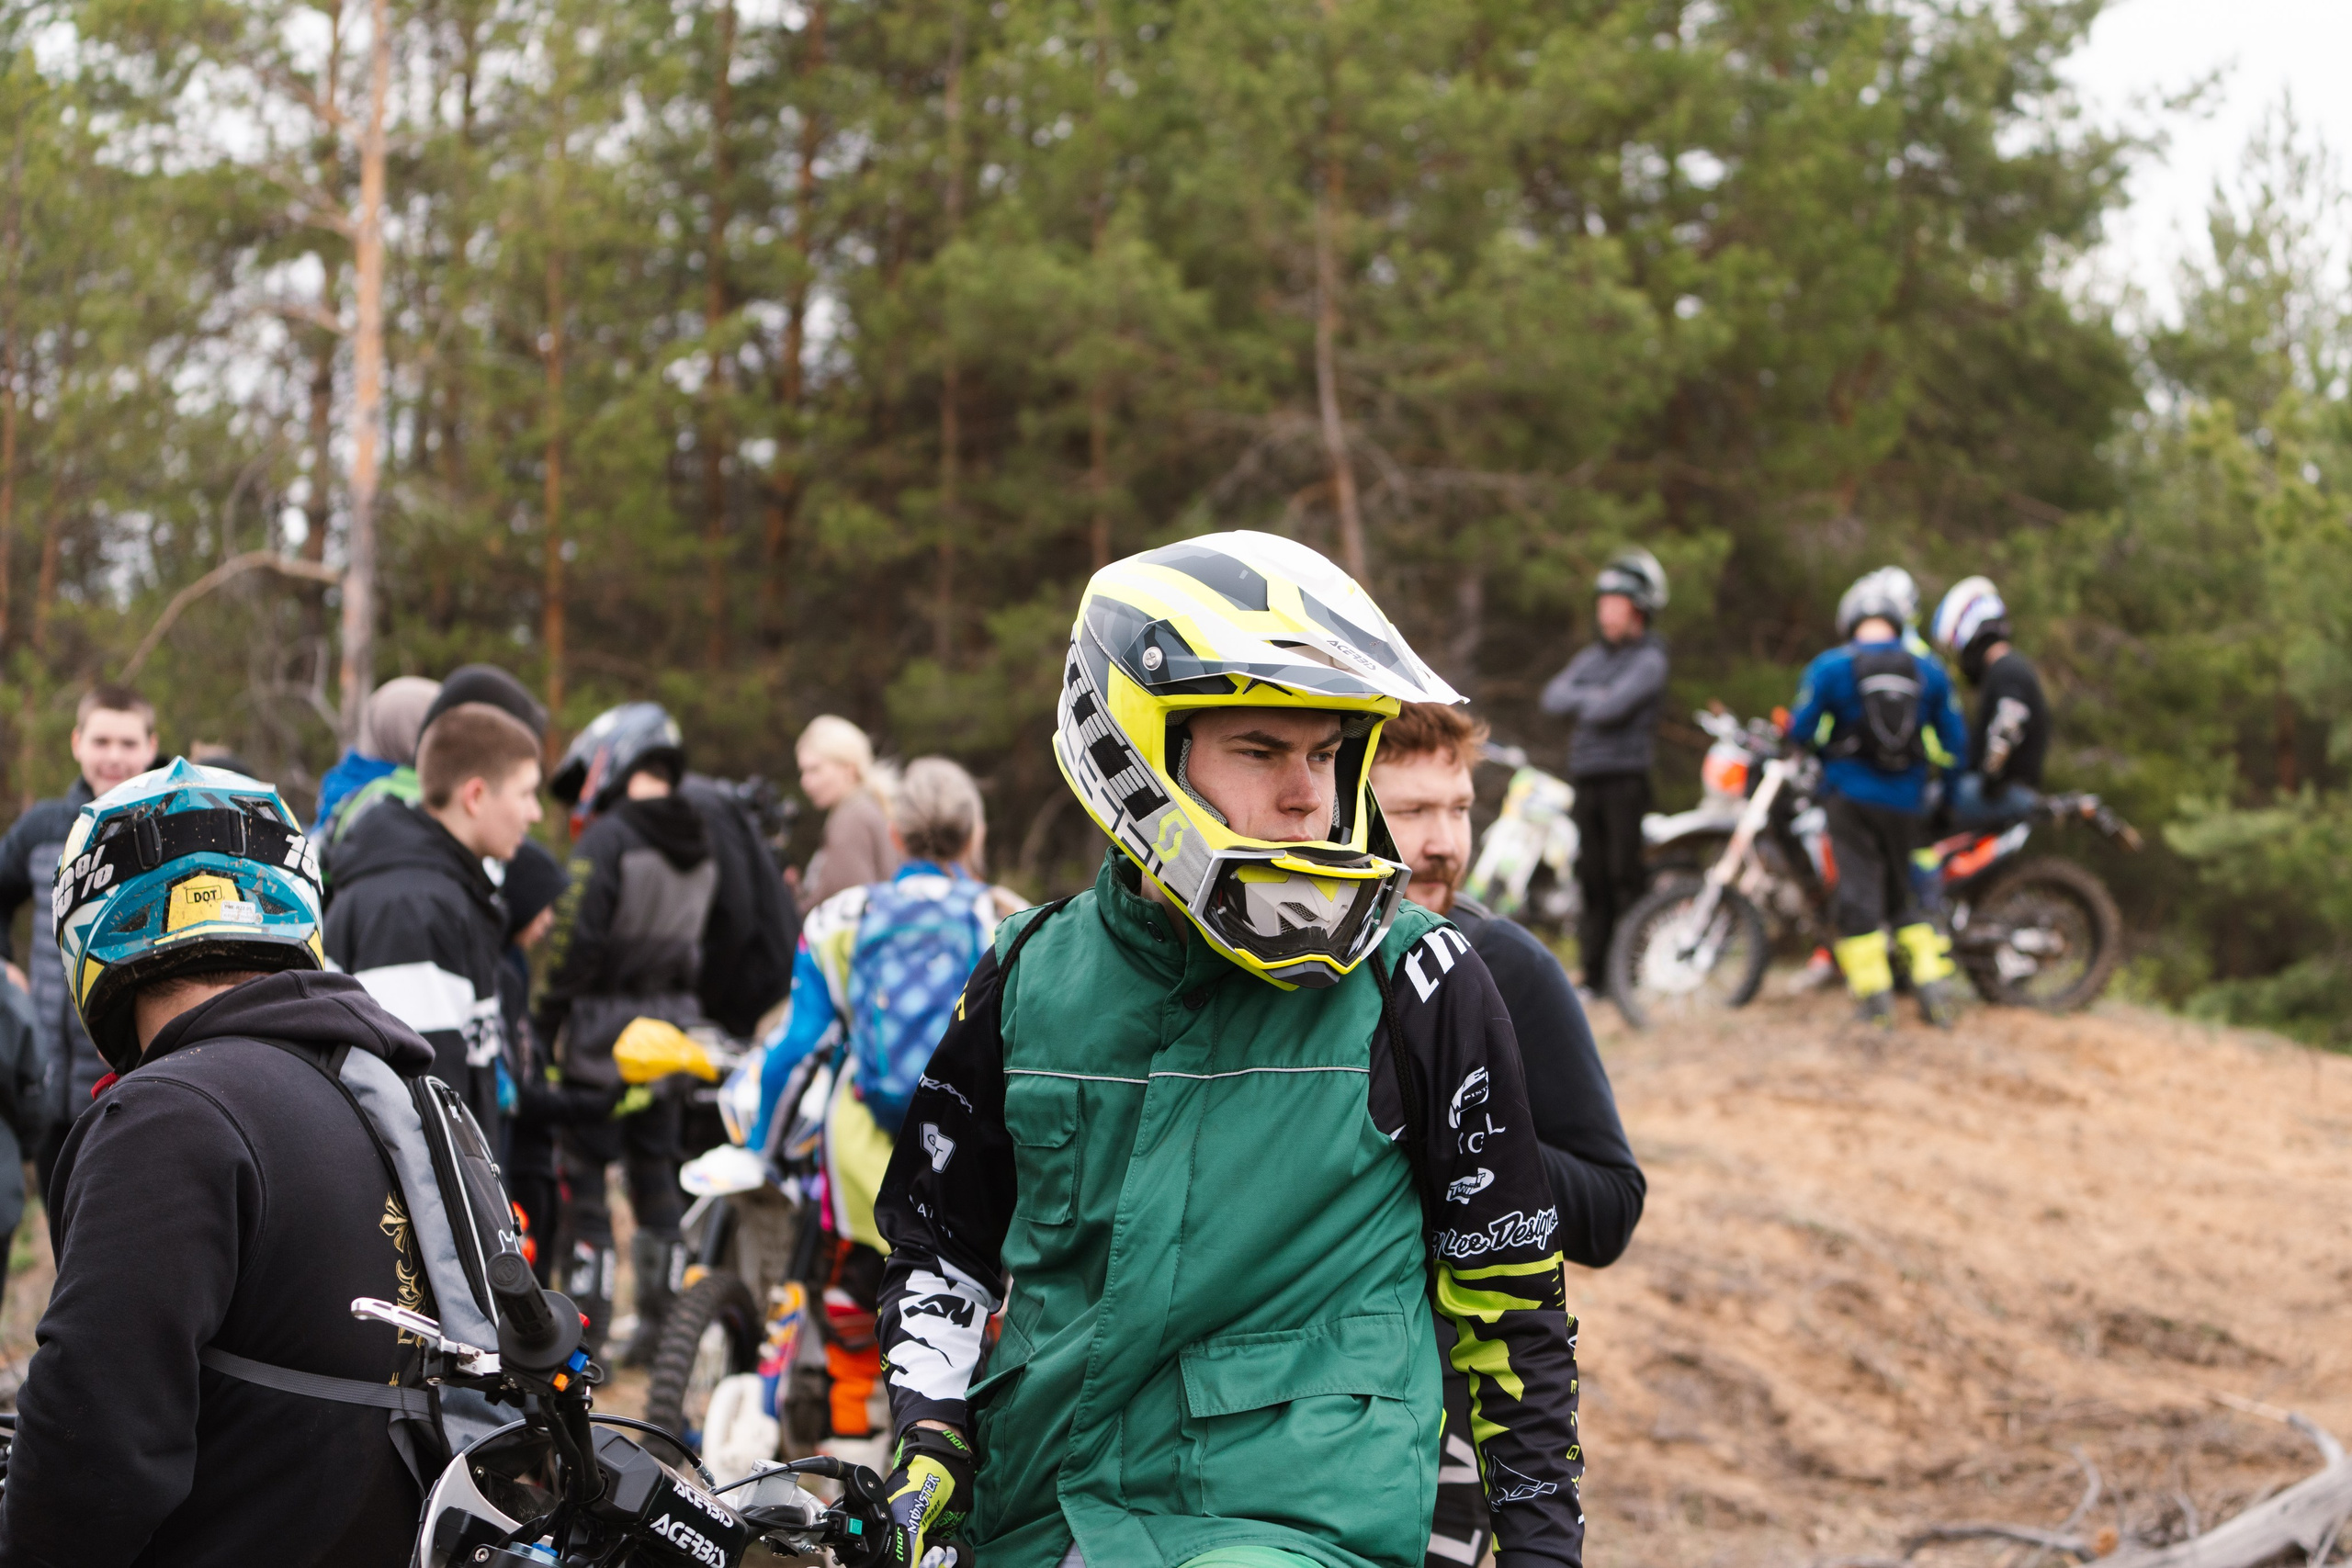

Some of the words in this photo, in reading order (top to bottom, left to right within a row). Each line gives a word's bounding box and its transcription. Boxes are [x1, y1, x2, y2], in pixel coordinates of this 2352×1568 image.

[194, 889, 217, 903] DOT
[1442, 1228, 1490, 1258] Lee
[943, 1429, 967, 1450] thor
[673, 1479, 734, 1528] ACERBIS
[649, 1513, 726, 1568] ACERBIS
[895, 1527, 904, 1562] thor
